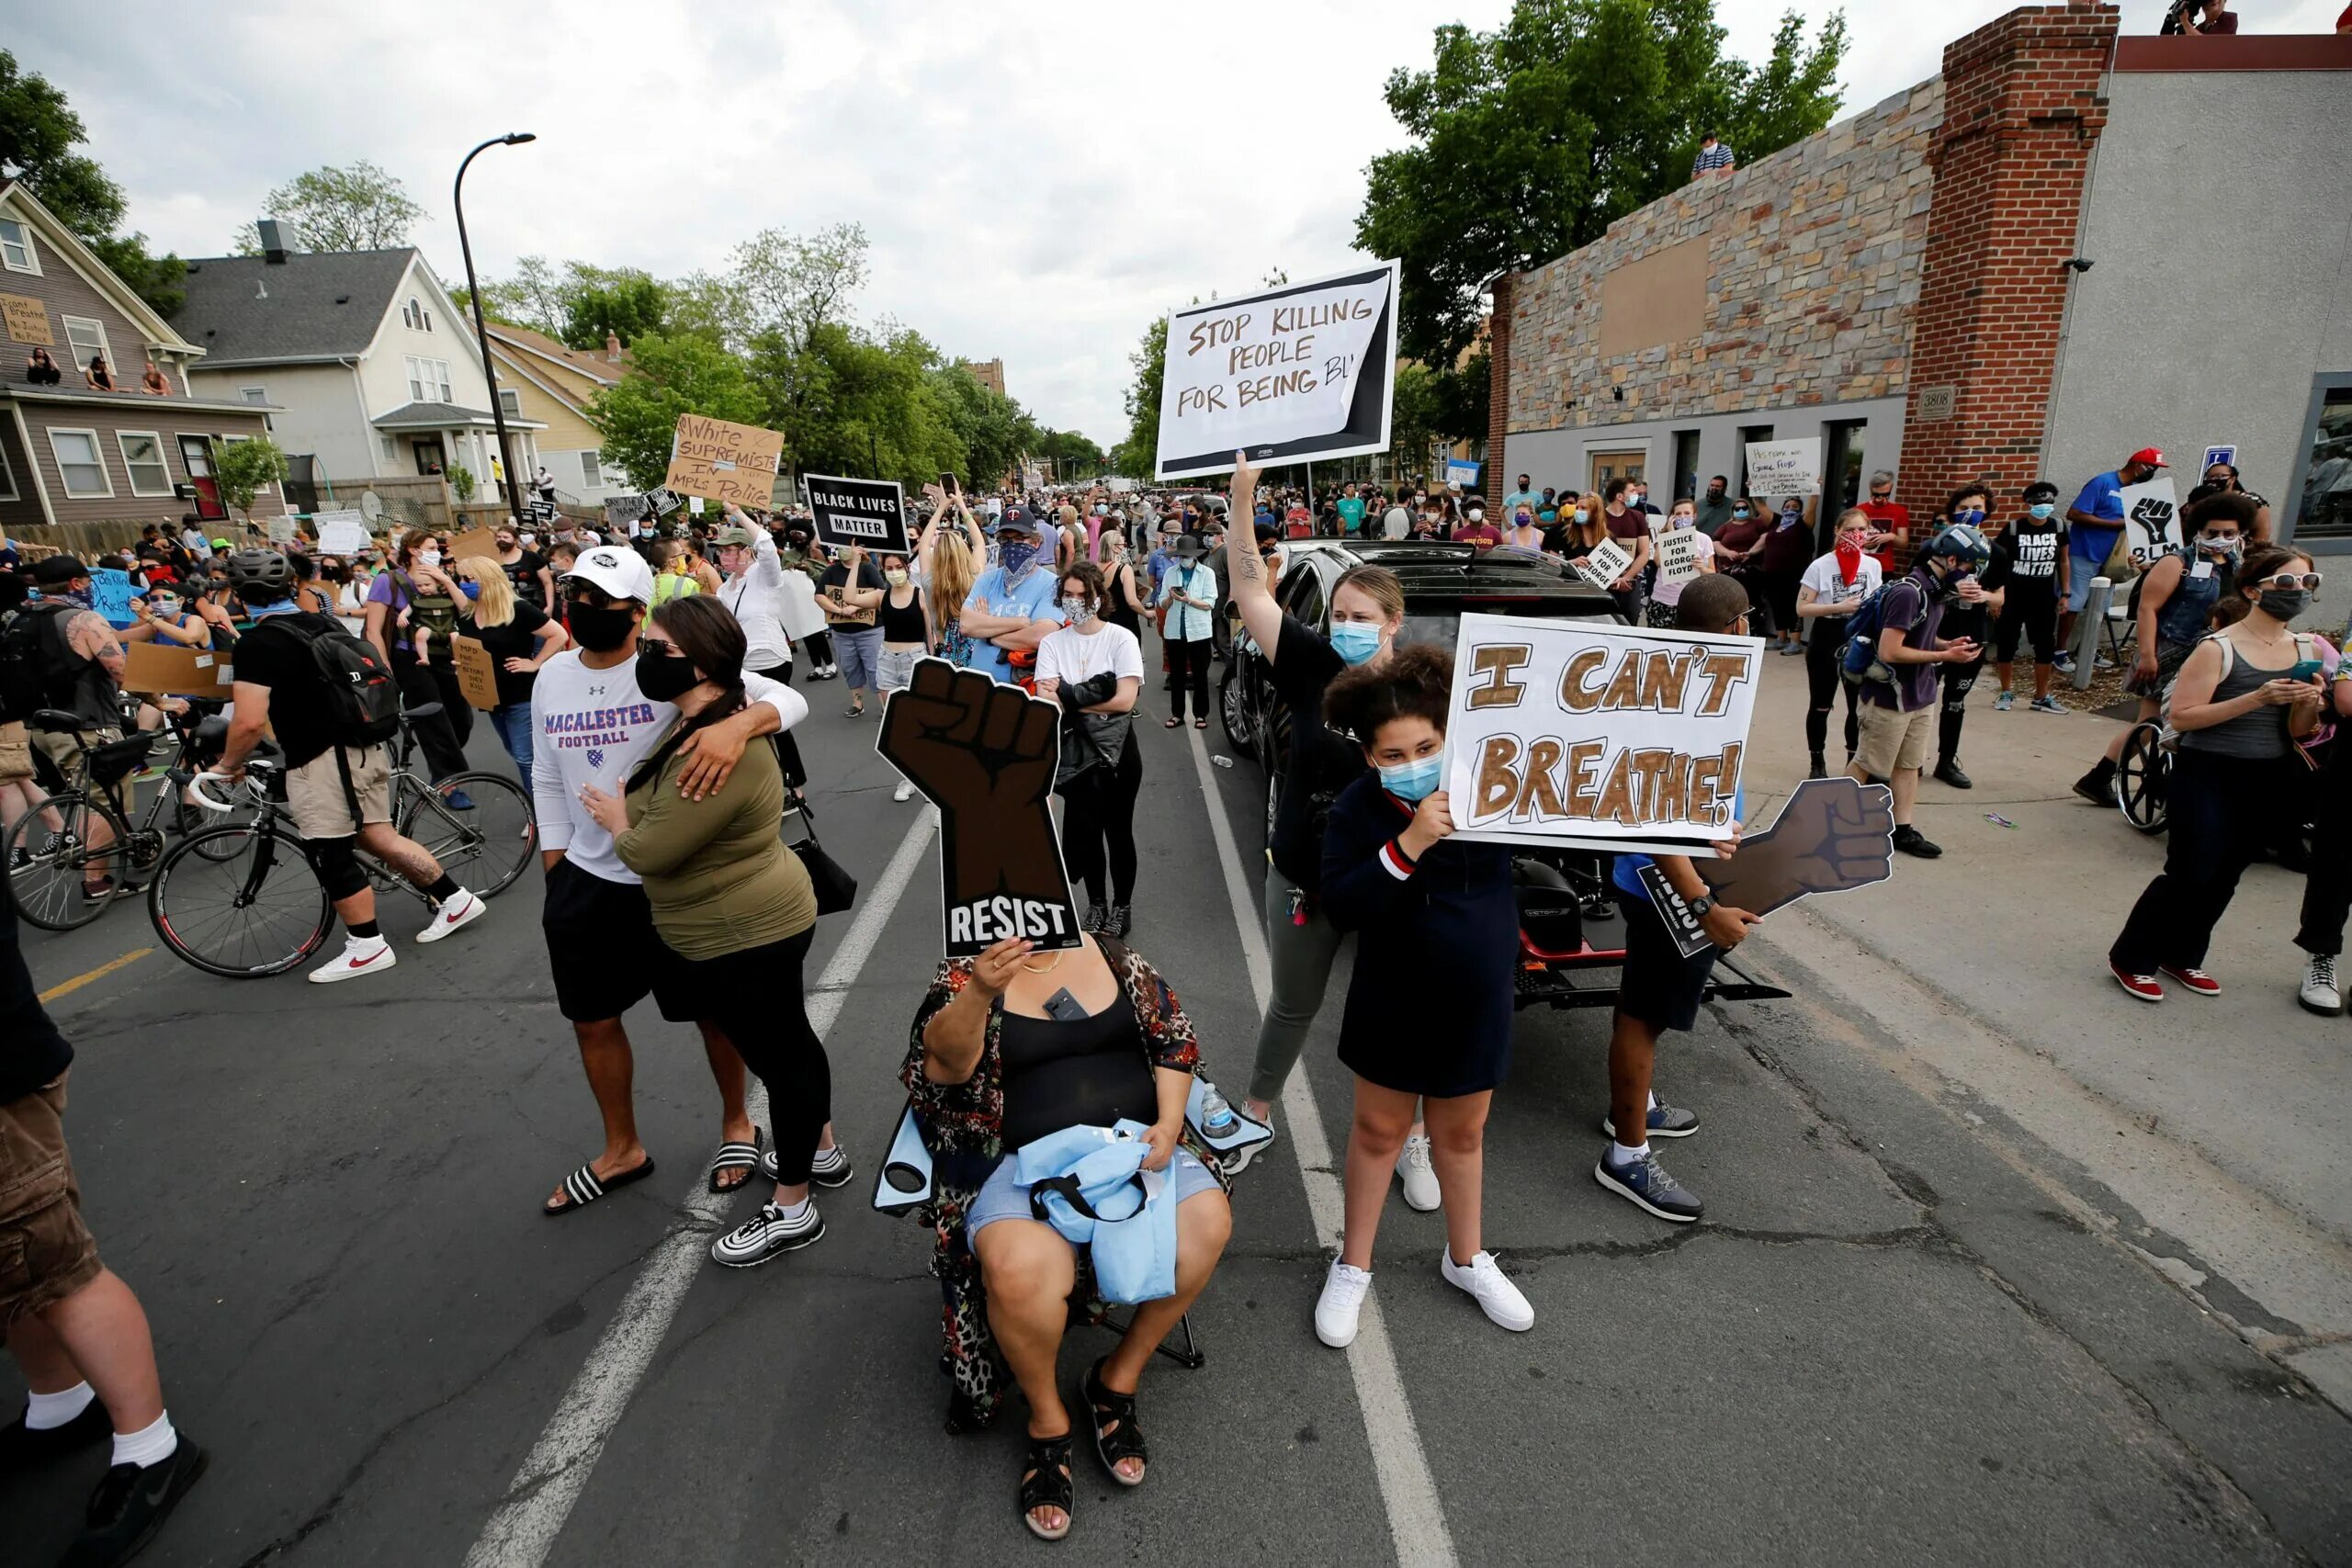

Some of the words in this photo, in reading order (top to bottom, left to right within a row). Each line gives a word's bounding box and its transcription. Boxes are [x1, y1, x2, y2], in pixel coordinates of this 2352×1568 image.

[1188, 314, 1251, 356] STOP
[1272, 299, 1373, 336] KILLING
[1229, 334, 1315, 376] PEOPLE
[1178, 384, 1227, 417] FOR
[1238, 369, 1317, 408] BEING
[1924, 392, 1949, 407] 3808
[687, 418, 742, 446] White
[689, 464, 719, 476] IN
[672, 473, 710, 491] MPLS
[717, 479, 768, 507] Police
[605, 497, 618, 507] SAY
[622, 496, 646, 507] THEIR
[813, 491, 855, 509] BLACK
[859, 497, 896, 513] LIVES
[834, 518, 883, 535] MATTER
[1663, 535, 1693, 547] JUSTICE
[2018, 533, 2057, 547] BLACK
[1599, 546, 1624, 569] JUSTICE
[1671, 547, 1687, 556] FOR
[2019, 546, 2056, 561] LIVES
[1597, 558, 1611, 570] FOR
[1664, 554, 1695, 567] GEORGE
[2012, 560, 2056, 576] MATTER
[1668, 565, 1692, 576] FLOYD
[1466, 643, 1532, 711] I
[1556, 645, 1751, 716] CAN'T
[545, 704, 655, 734] MACALESTER
[559, 731, 629, 748] FOOTBALL
[1467, 732, 1742, 828] BREATHE!
[951, 895, 1066, 942] RESIST
